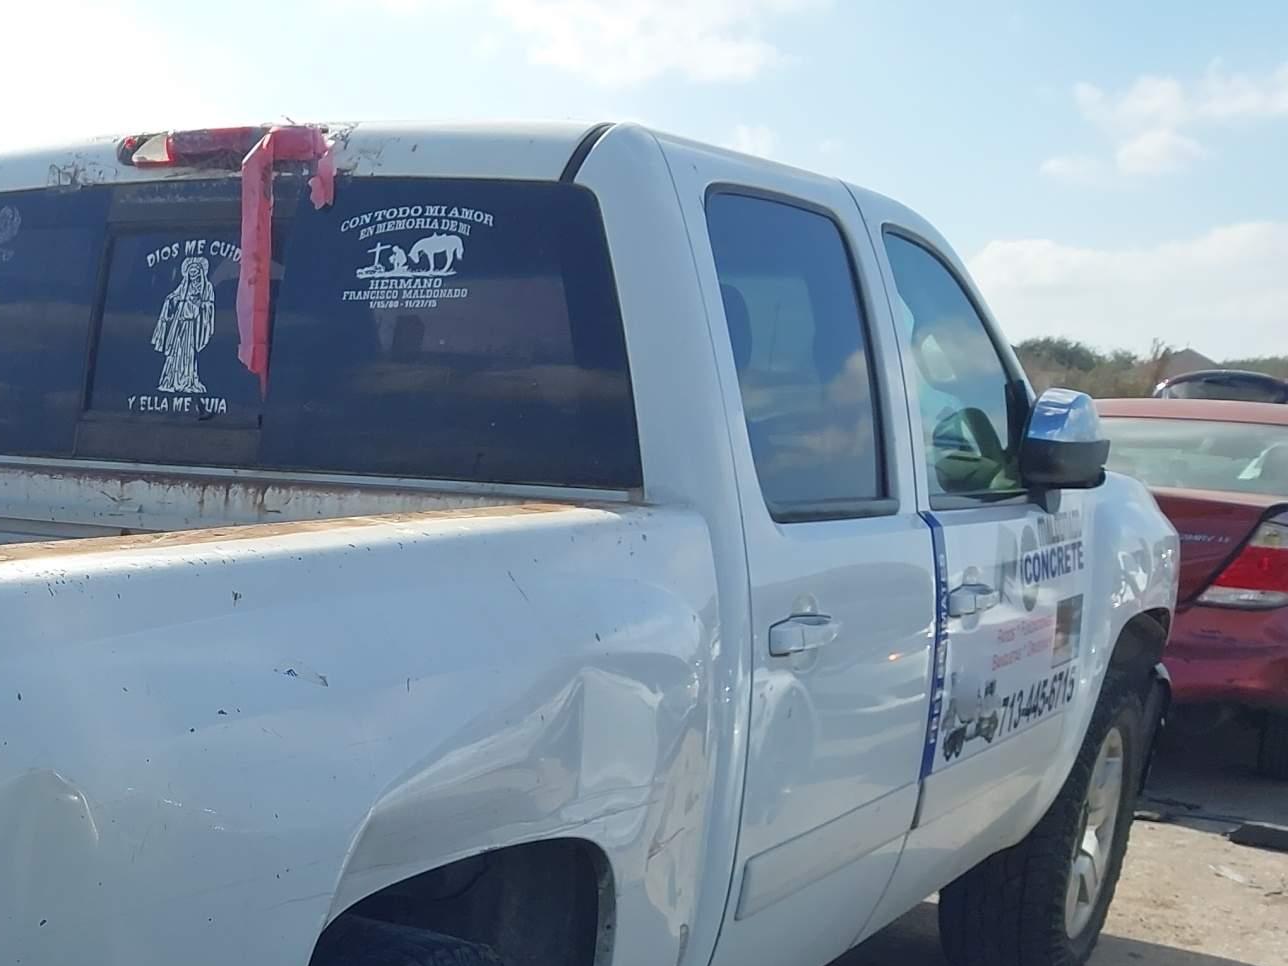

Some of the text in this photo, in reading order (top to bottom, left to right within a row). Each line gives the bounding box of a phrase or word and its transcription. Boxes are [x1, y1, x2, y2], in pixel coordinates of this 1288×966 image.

[341, 205, 494, 232] CON TODO MI AMOR
[359, 218, 472, 240] EN MEMORIA DE MI
[147, 239, 243, 268] DIOS ME CUID
[342, 288, 468, 301] FRANCISCO MALDONADO
[369, 278, 443, 290] HERMANO
[128, 395, 227, 413] Y ELLA ME UIA
[1024, 541, 1084, 585] CONCRETE
[999, 666, 1076, 736] 713-445-6715
